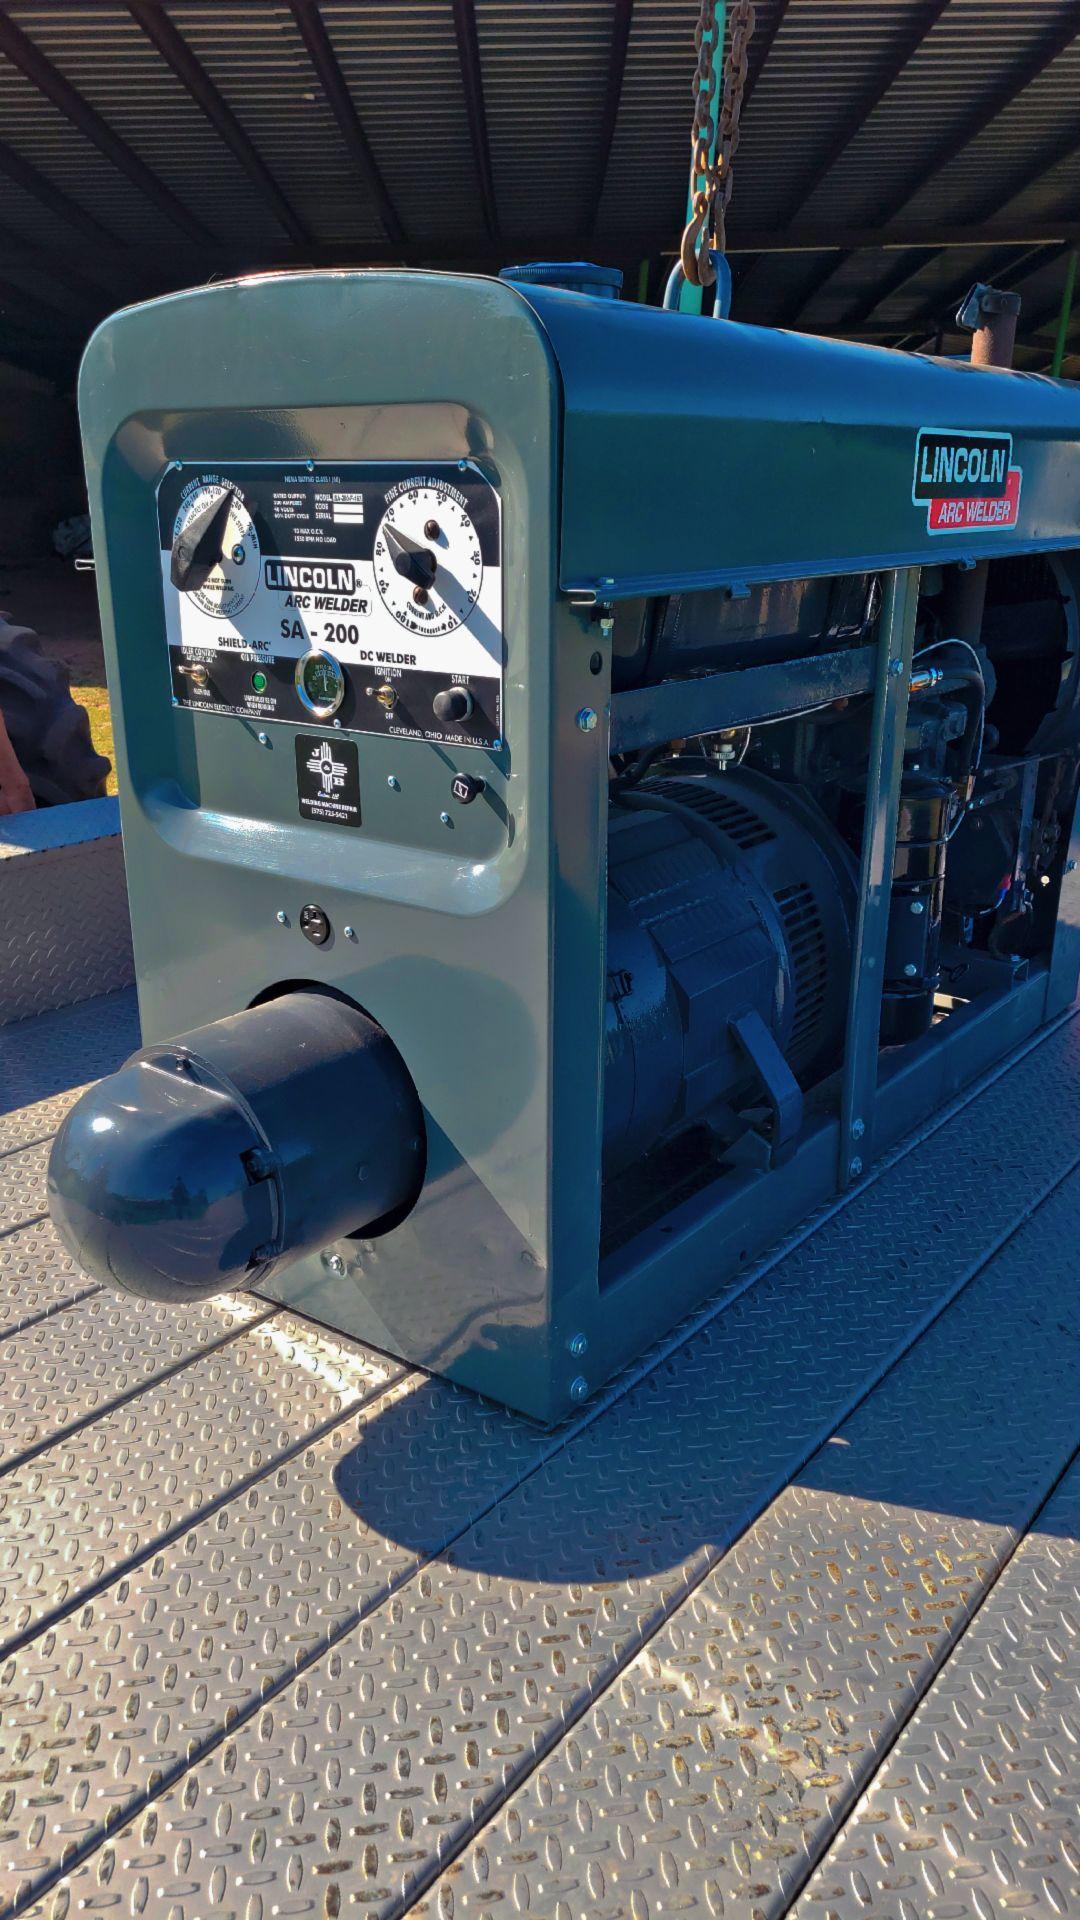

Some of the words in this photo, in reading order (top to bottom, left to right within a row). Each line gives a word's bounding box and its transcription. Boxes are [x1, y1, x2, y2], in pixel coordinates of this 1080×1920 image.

[920, 446, 1006, 483] LINCOLN
[384, 486, 400, 504] FINE
[398, 476, 427, 493] CURRENT
[427, 476, 469, 508] ADJUSTMENT
[407, 490, 419, 500] 60
[436, 491, 447, 502] 50
[385, 507, 396, 522] 70
[938, 502, 965, 524] ARC
[966, 500, 1011, 522] WELDER
[460, 514, 471, 528] 40
[376, 541, 383, 556] 80
[473, 550, 481, 566] 30
[266, 565, 353, 591] LINCOLN
[284, 594, 311, 609] ARC
[314, 596, 368, 613] WELDER
[467, 588, 477, 604] 20
[395, 610, 410, 627] 100
[447, 617, 459, 629] 10
[194, 648, 217, 658] CONTROL
[240, 652, 250, 662] OIL
[250, 653, 275, 664] PRESSURE
[360, 650, 374, 661] DC
[376, 651, 417, 665] WELDER
[374, 666, 402, 677] IGNITION
[451, 674, 469, 685] START
[192, 700, 213, 710] LINCOLN
[214, 703, 235, 713] ELECTRIC
[235, 706, 261, 716] COMPANY
[385, 712, 394, 720] OFF
[424, 730, 442, 740] OHIO
[444, 734, 463, 744] MADE
[464, 736, 472, 744] IN
[311, 748, 320, 757] J
[332, 777, 345, 786] B
[301, 798, 321, 807] WELDING
[321, 801, 341, 810] MACHINE
[341, 804, 358, 813] REPAIR
